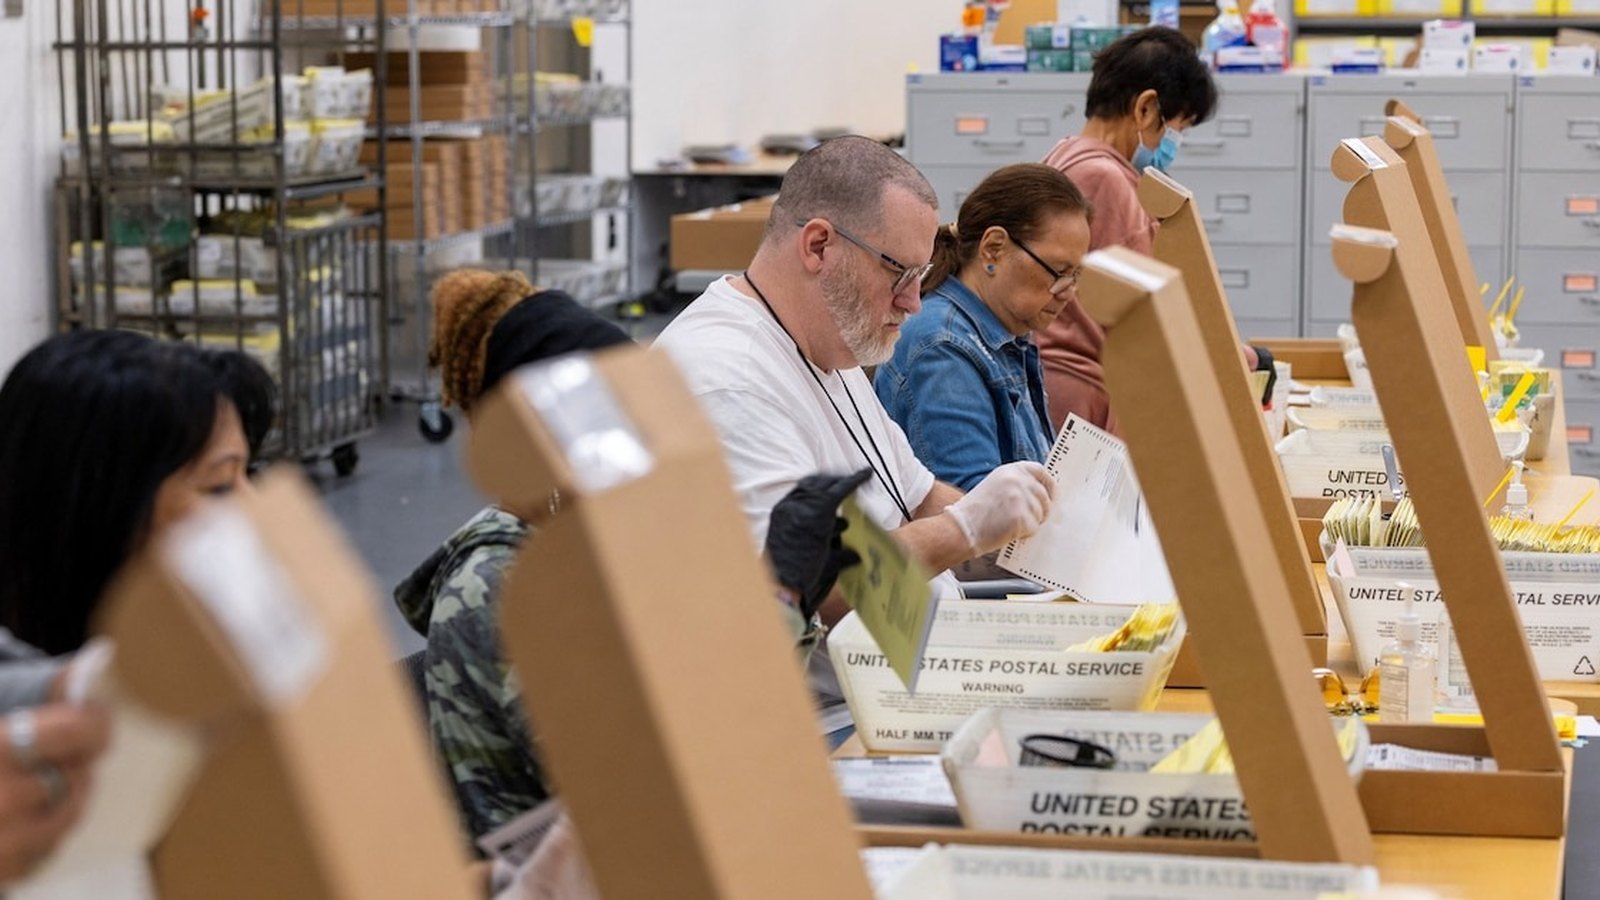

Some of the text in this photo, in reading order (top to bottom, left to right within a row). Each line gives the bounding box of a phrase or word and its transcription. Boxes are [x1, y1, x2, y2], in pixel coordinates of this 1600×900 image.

[1327, 470, 1388, 485] UNITED
[1322, 488, 1382, 501] POSTA
[1413, 589, 1444, 602] STA
[1516, 592, 1600, 606] TAL SERVI
[847, 652, 891, 668] UNIT
[988, 660, 1059, 676] POSTAL
[1065, 661, 1144, 677] SERVICE
[962, 681, 1025, 695] WARNING
[876, 729, 909, 740] HALF
[913, 730, 935, 741] MM
[1030, 792, 1139, 817] UNITED
